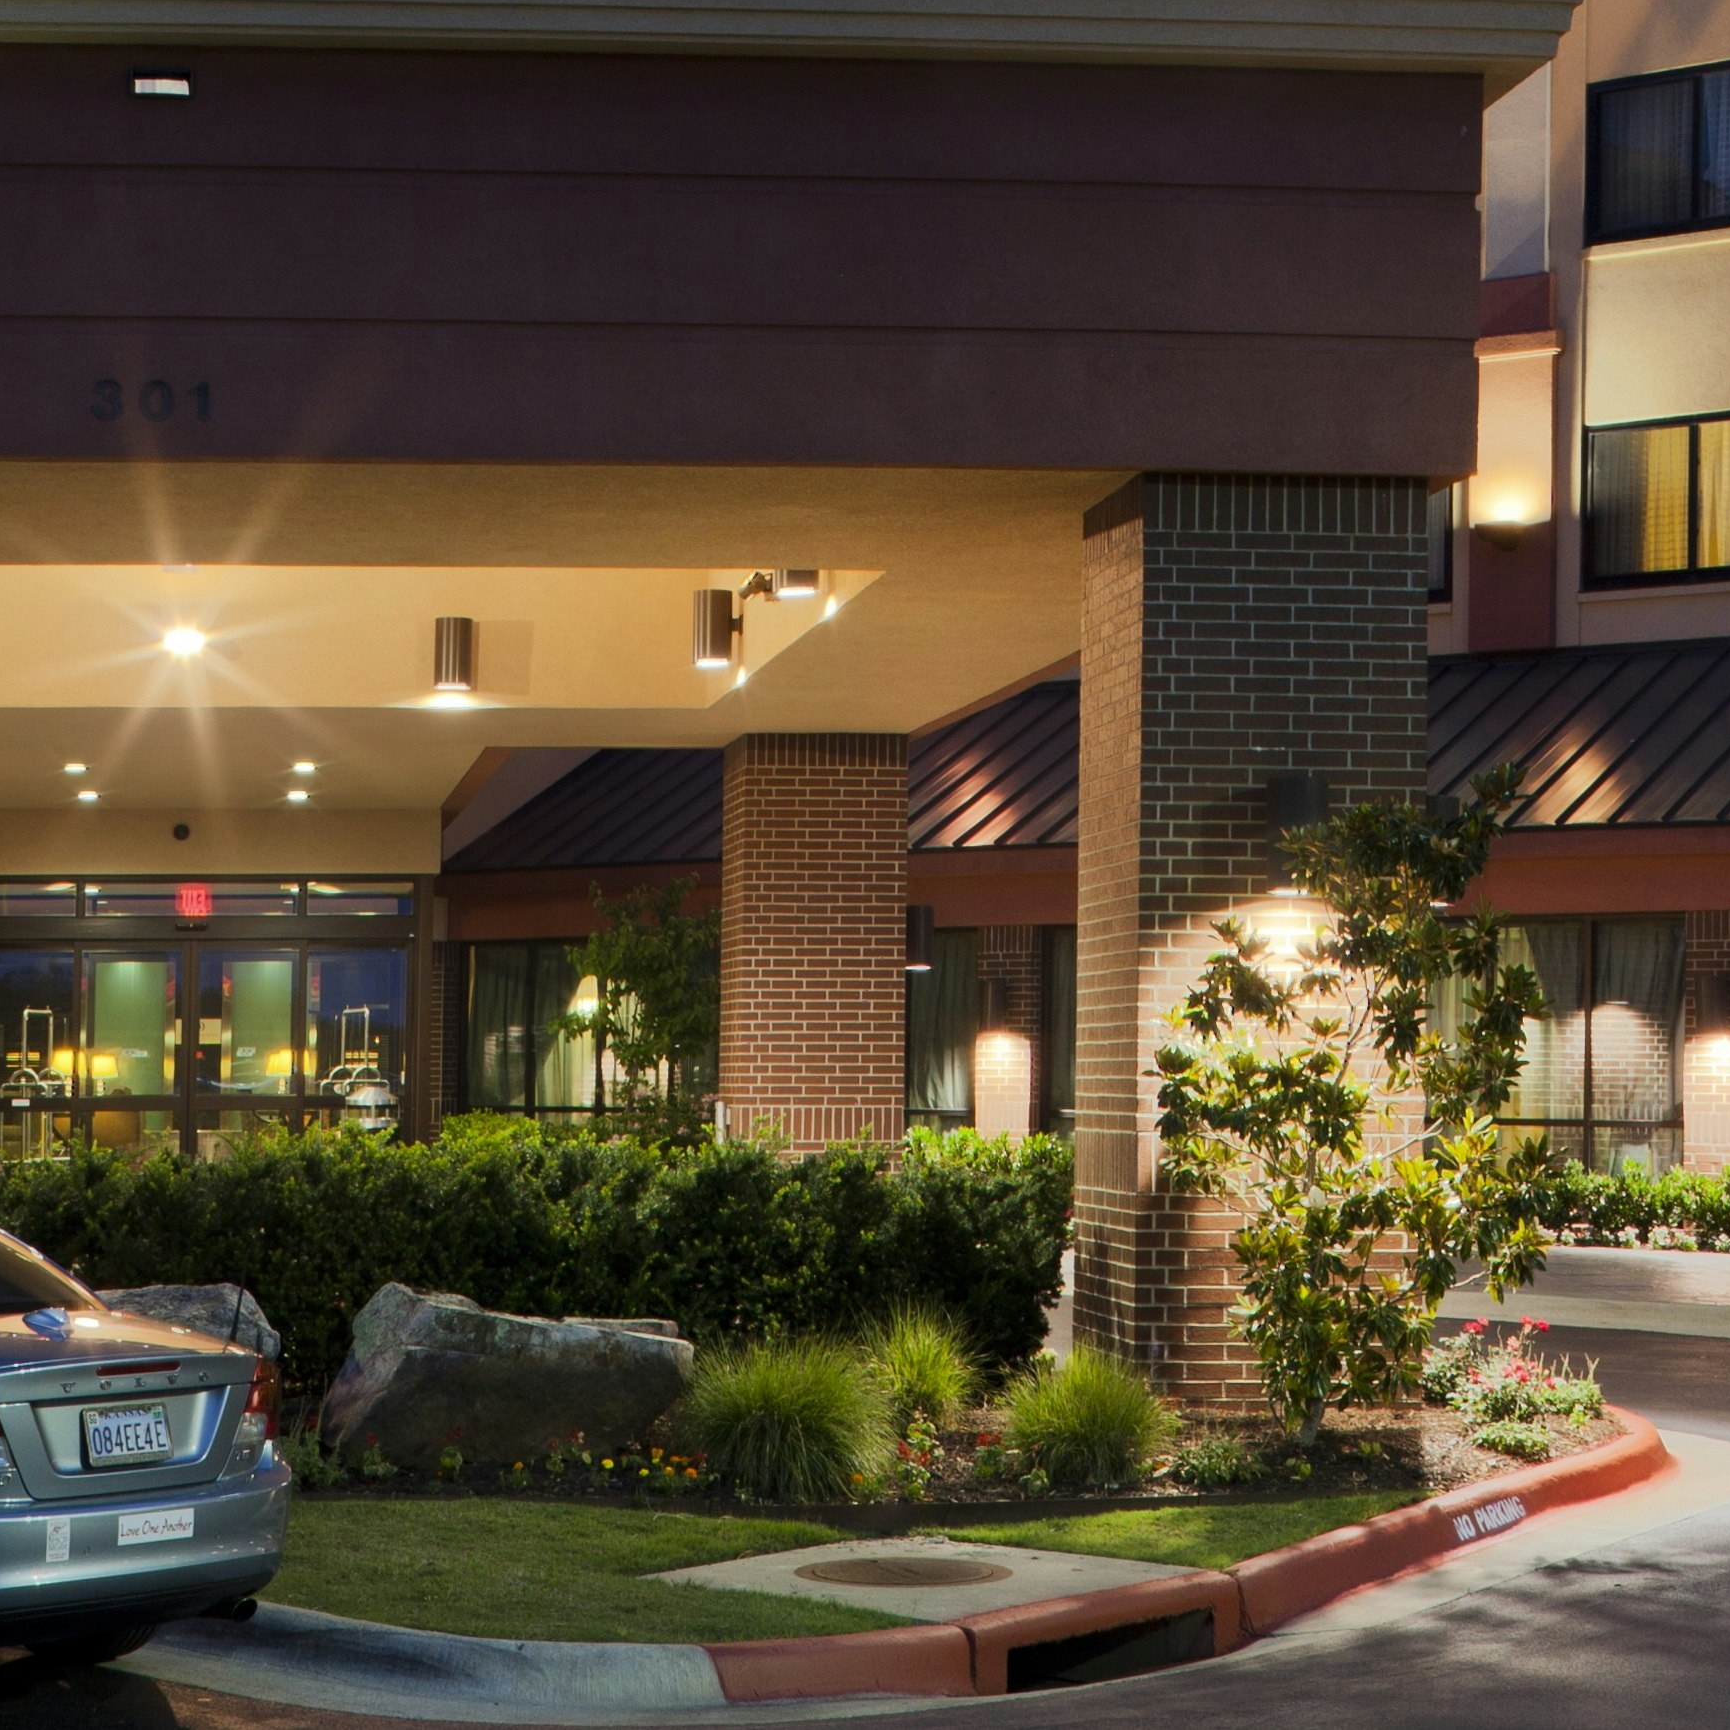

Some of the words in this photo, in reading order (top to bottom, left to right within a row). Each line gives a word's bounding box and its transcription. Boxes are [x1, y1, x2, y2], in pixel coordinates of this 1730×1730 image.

[91, 379, 212, 421] 301
[61, 1372, 208, 1393] VOLVO
[92, 1421, 167, 1456] 084EE4E
[120, 1523, 140, 1537] Love
[142, 1520, 159, 1535] One
[160, 1516, 193, 1535] Another
[1452, 1514, 1476, 1542] NO
[1473, 1496, 1527, 1534] PARKING
